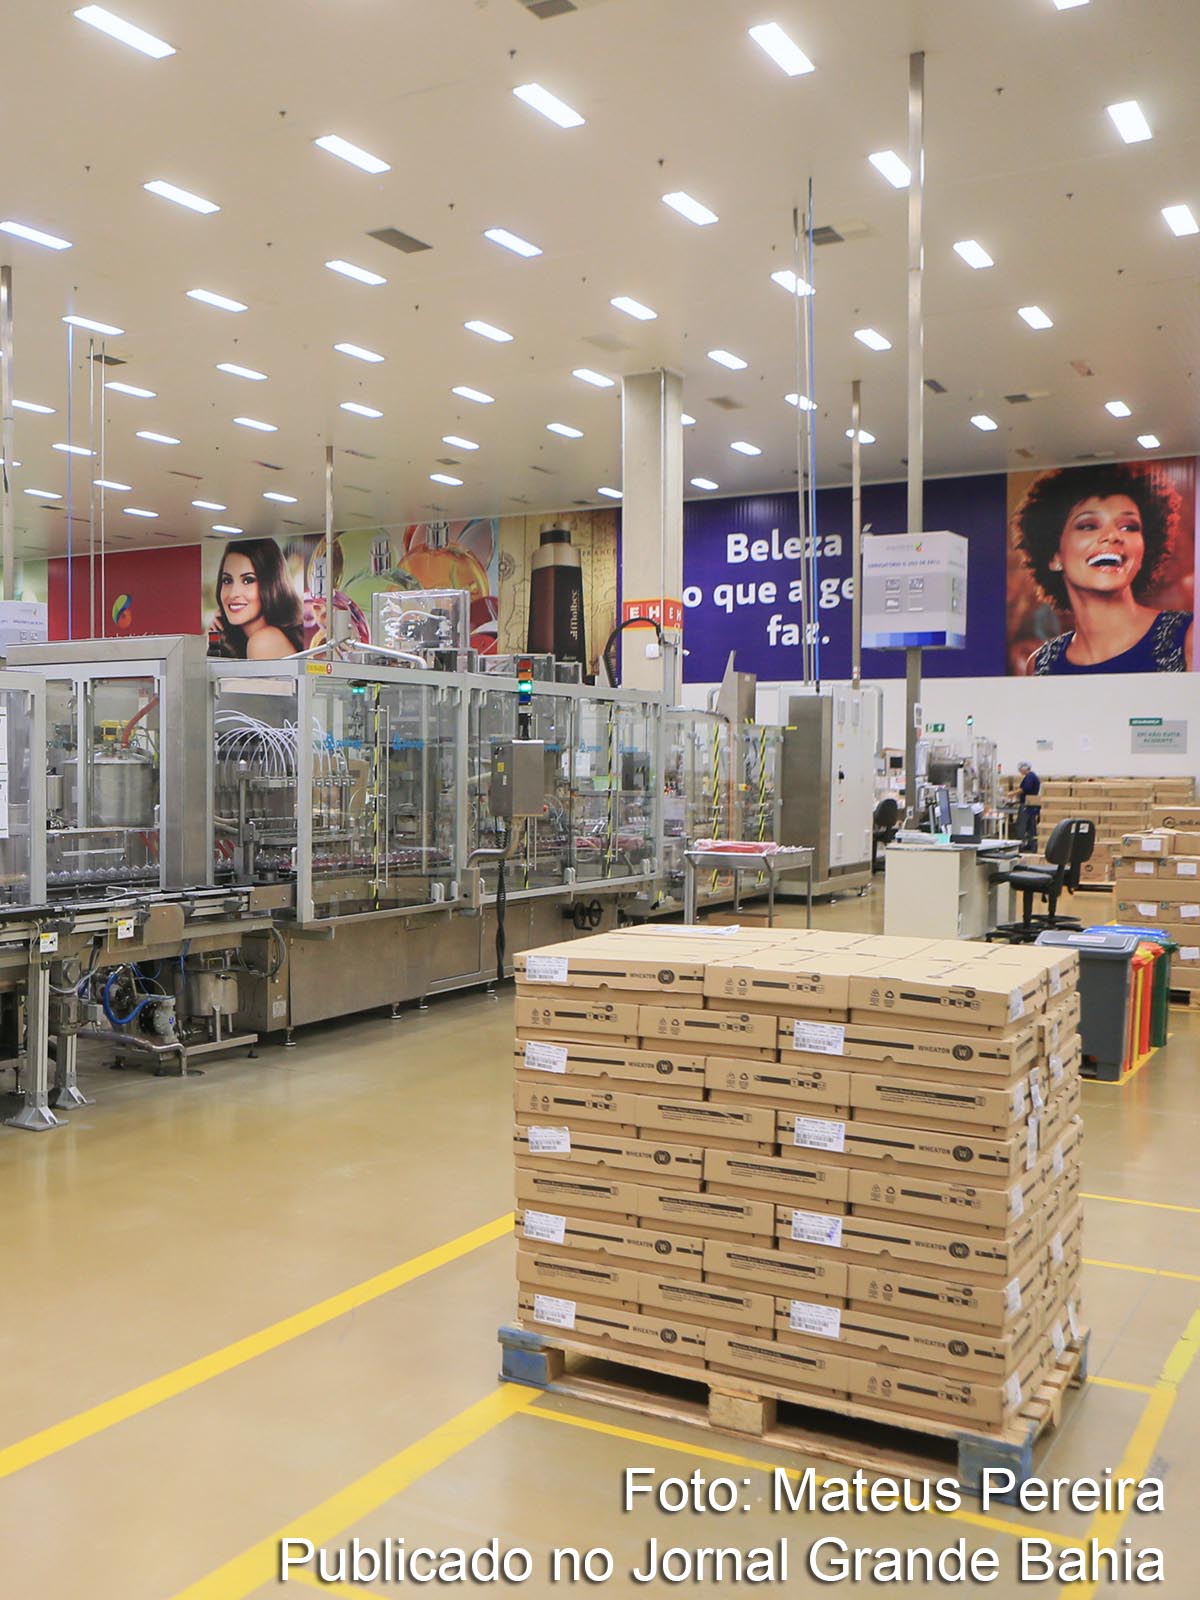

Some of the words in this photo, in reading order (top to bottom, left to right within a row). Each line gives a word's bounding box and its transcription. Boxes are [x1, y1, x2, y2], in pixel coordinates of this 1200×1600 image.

[726, 528, 843, 564] Beleza
[629, 606, 640, 619] E
[648, 606, 660, 619] H
[683, 585, 703, 608] o
[713, 579, 777, 613] que
[788, 579, 803, 603] a
[766, 614, 830, 646] faz.
